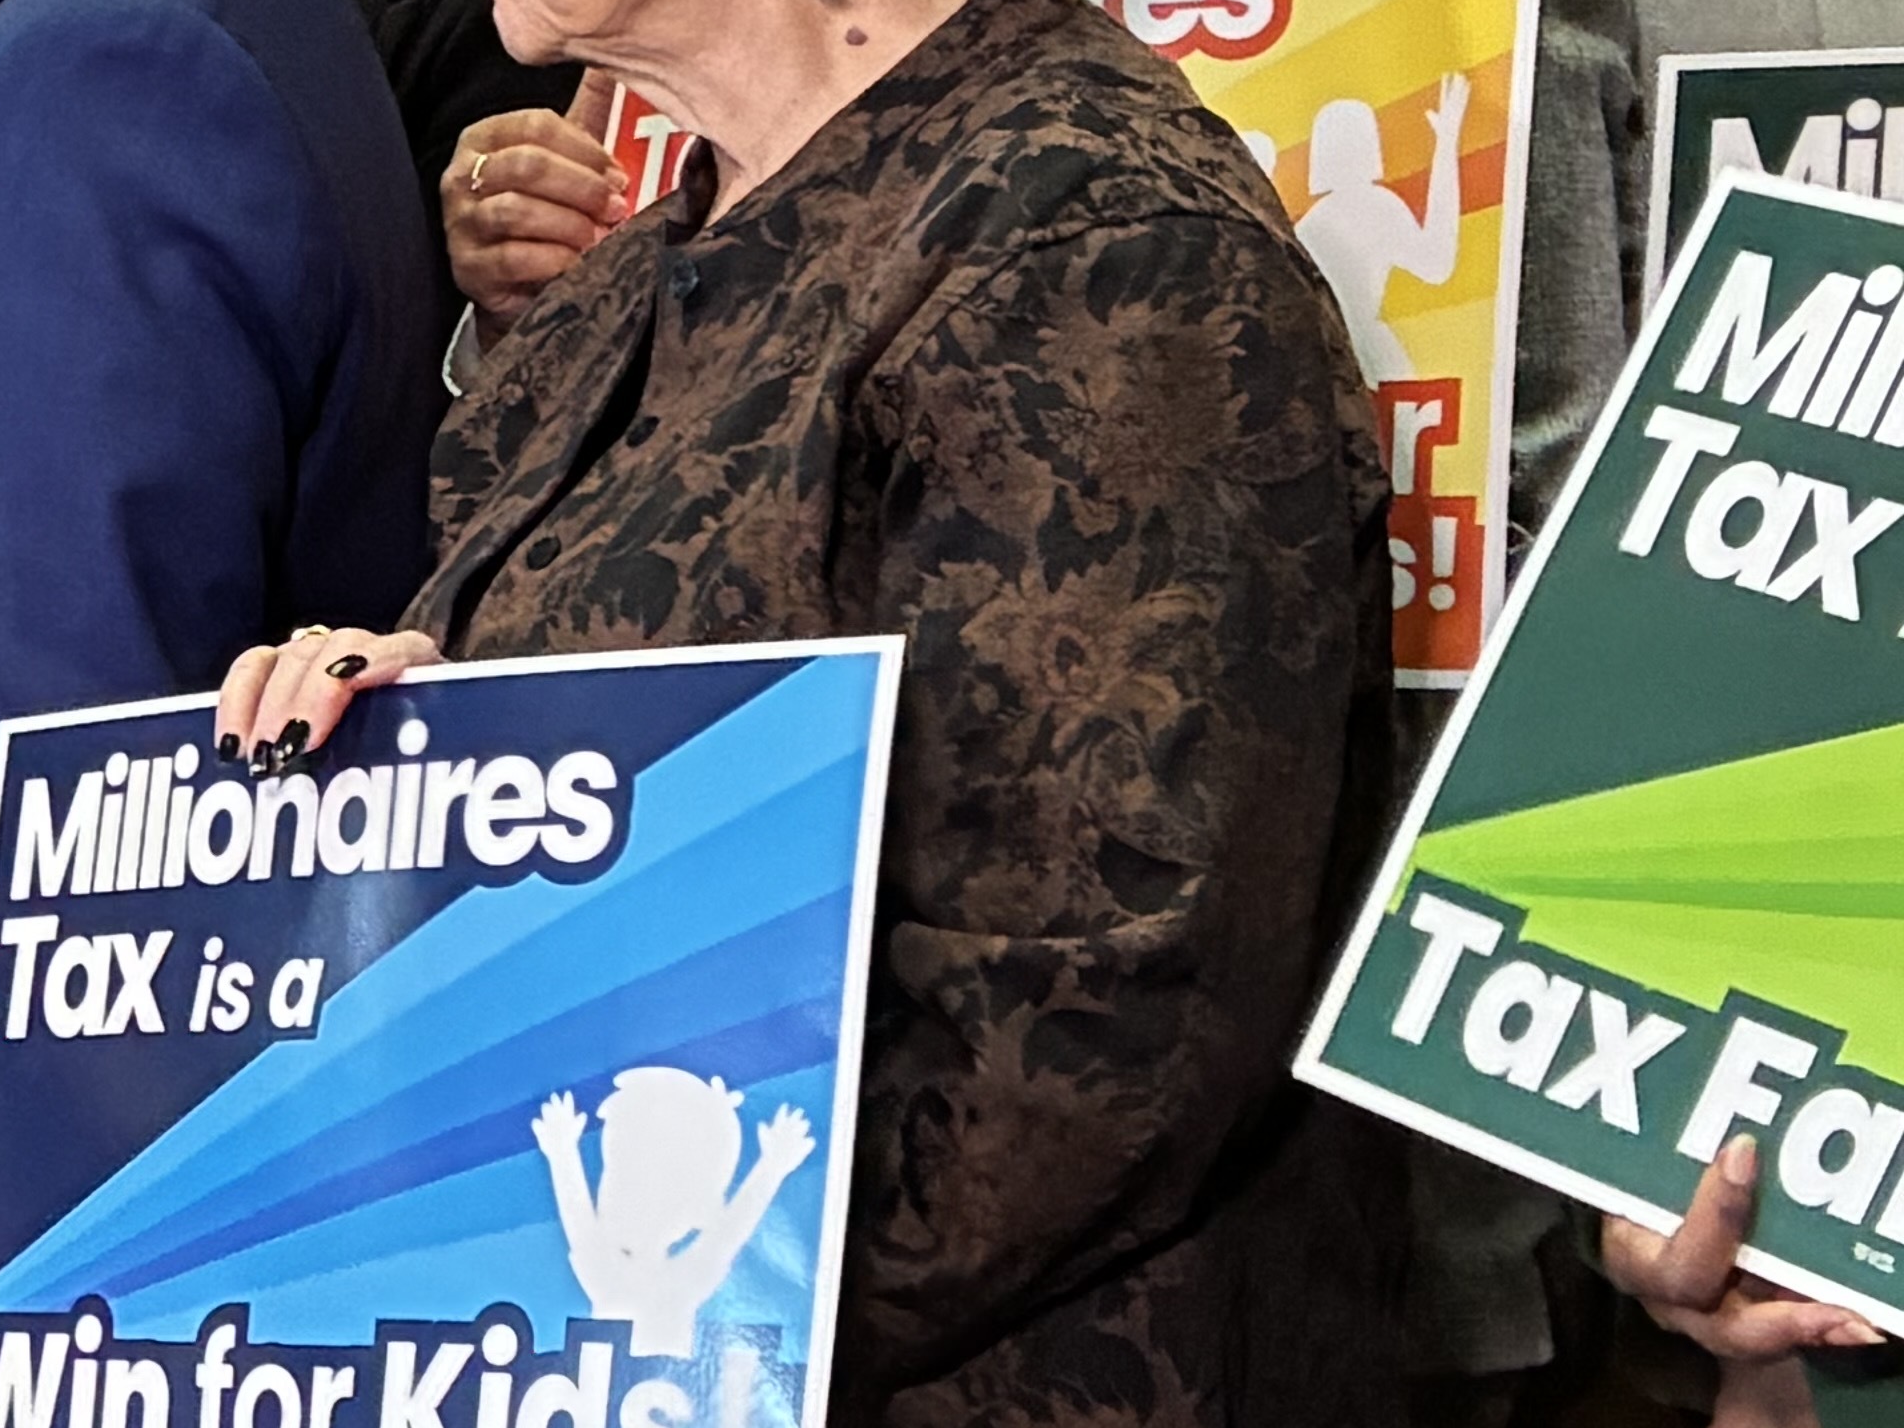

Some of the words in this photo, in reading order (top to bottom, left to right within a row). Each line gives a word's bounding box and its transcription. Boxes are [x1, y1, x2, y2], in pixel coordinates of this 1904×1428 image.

[1618, 404, 1904, 622] Tax
[9, 718, 618, 902] Millionaires
[0, 914, 174, 1041] Tax
[188, 937, 254, 1033] is
[268, 957, 324, 1029] a
[1391, 892, 1688, 1136] Tax
